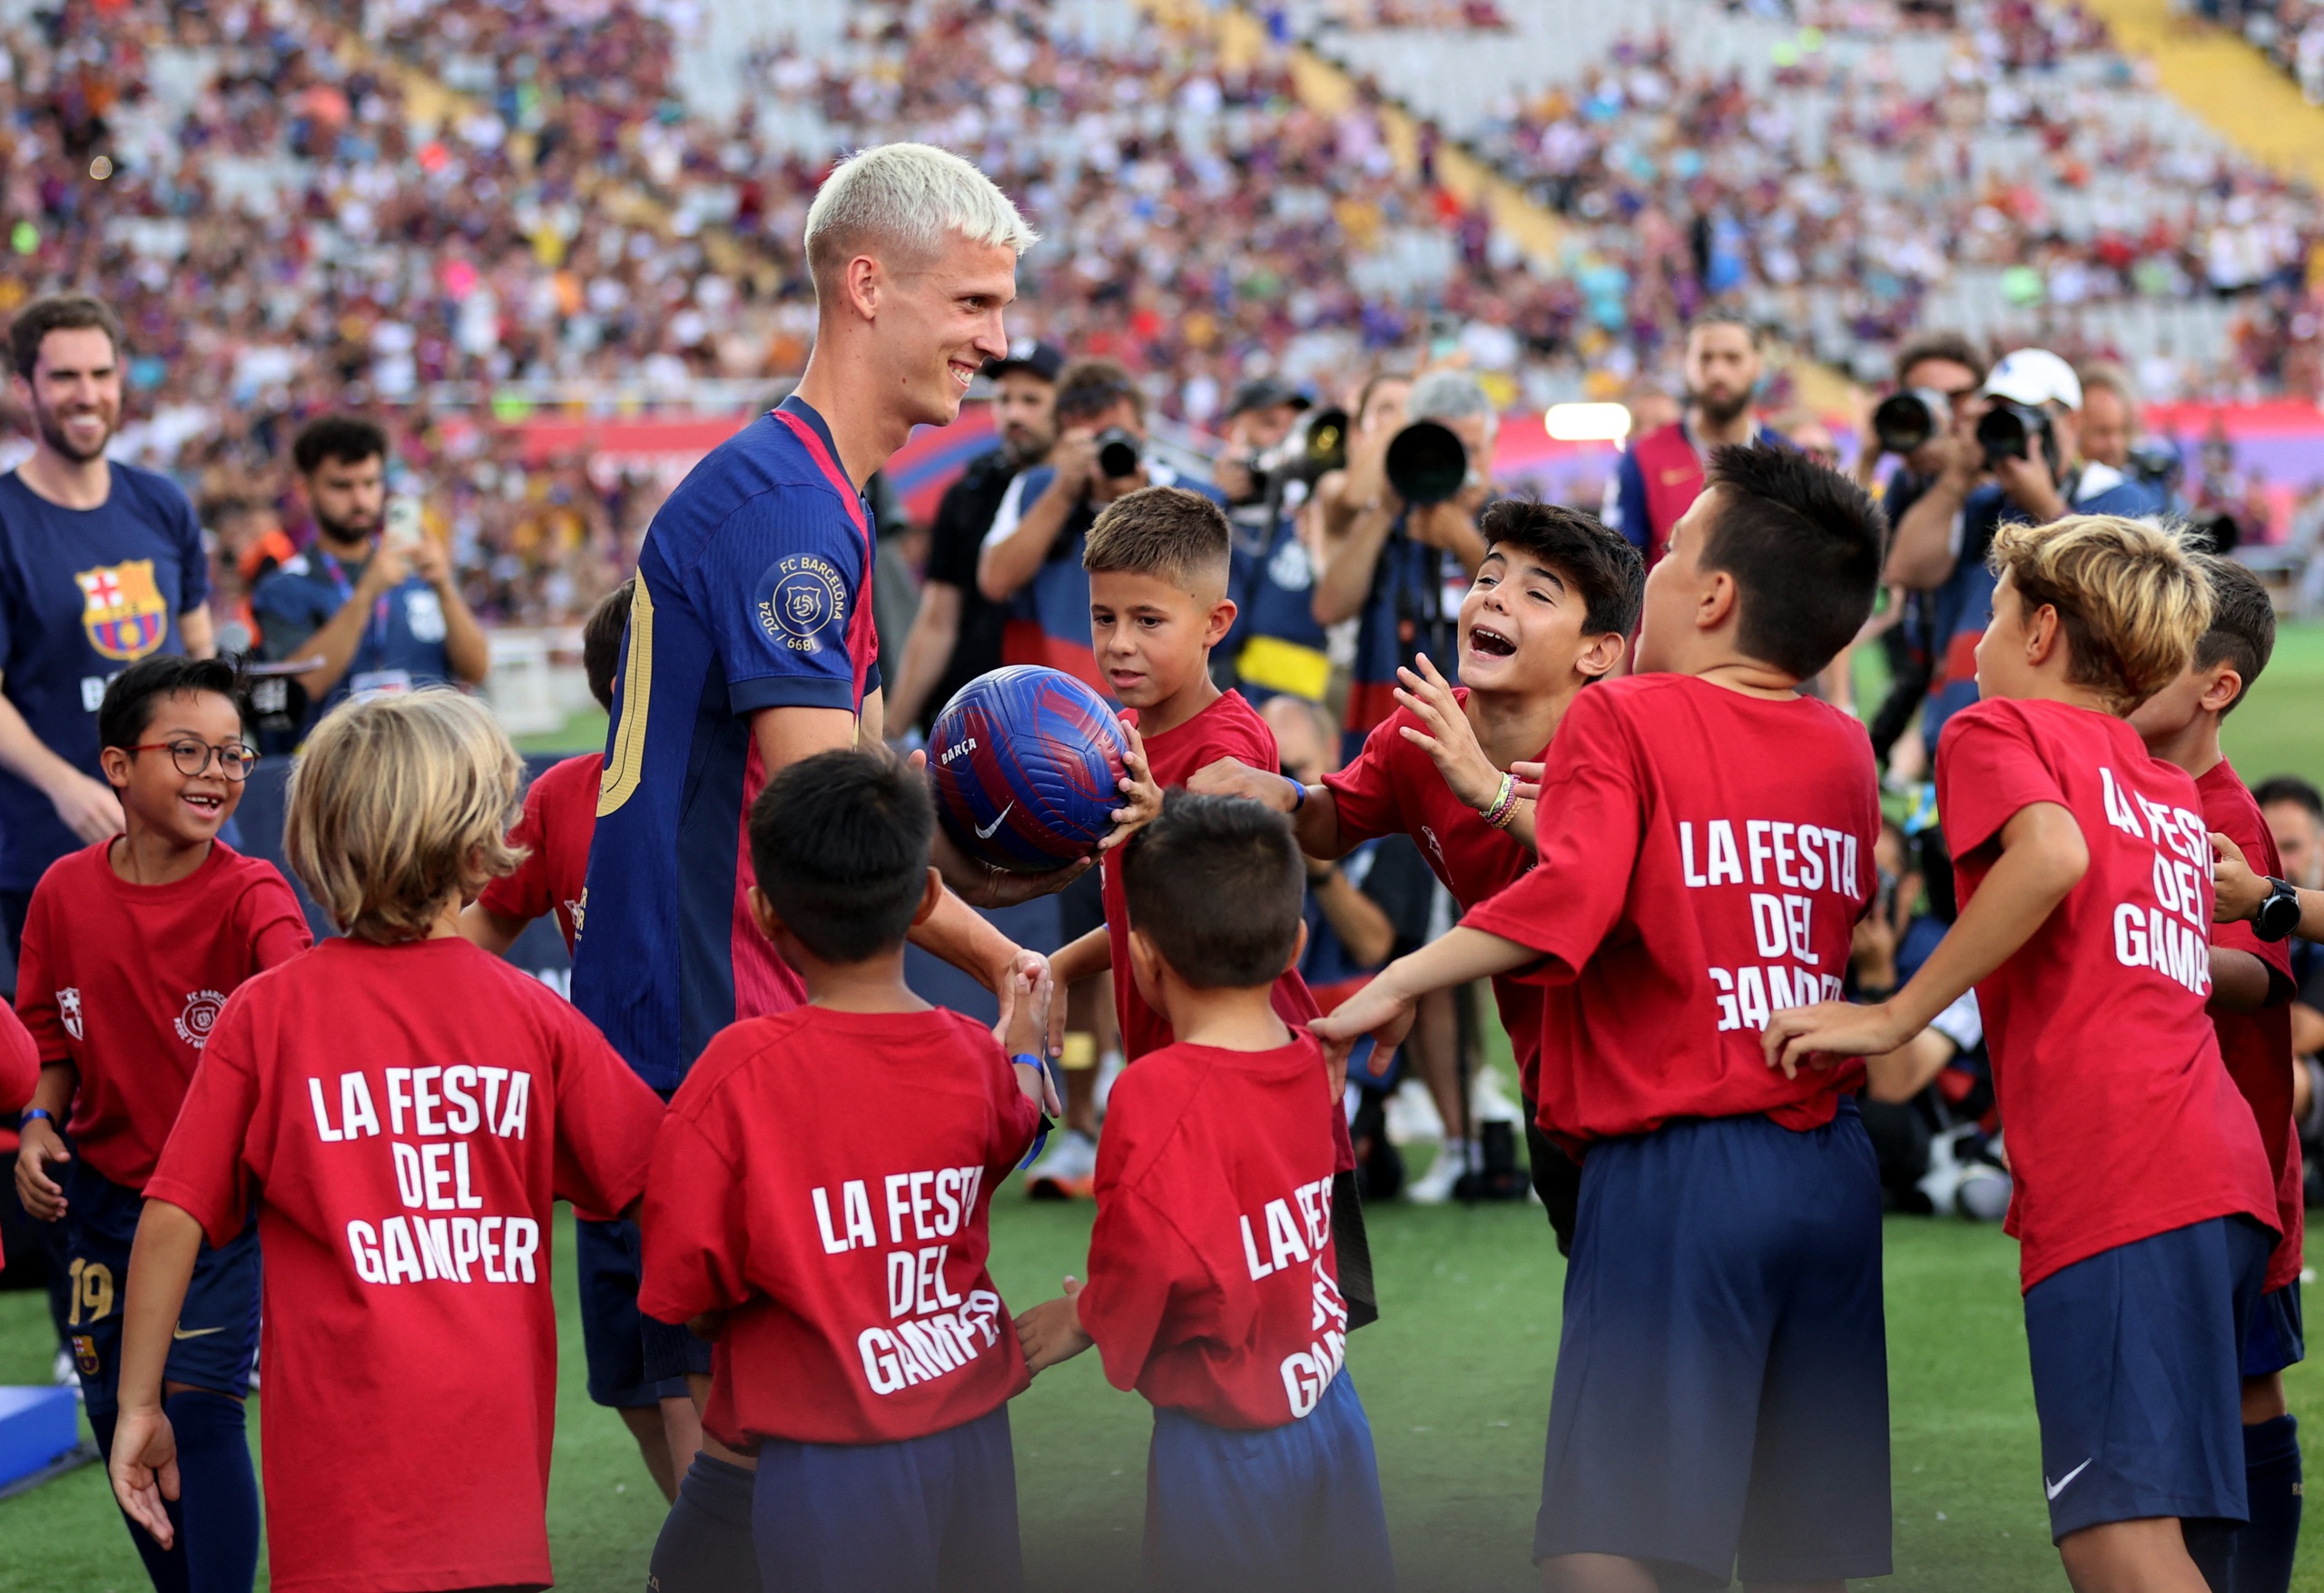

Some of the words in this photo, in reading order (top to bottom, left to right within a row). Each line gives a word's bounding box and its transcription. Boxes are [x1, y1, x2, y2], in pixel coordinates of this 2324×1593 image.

[759, 601, 780, 635] 2024
[779, 558, 797, 574] FC
[801, 556, 844, 620] BARCELONA
[787, 637, 816, 651] 1899
[940, 737, 977, 765] BARÇA
[2099, 767, 2144, 839] LA
[1679, 819, 1744, 888] LA
[1746, 819, 1860, 900] FESTA
[2152, 848, 2206, 937] DEL
[1749, 892, 1819, 965] DEL
[2113, 902, 2212, 997] GAMP
[308, 1071, 380, 1142] LA
[385, 1064, 531, 1141] FESTA
[391, 1141, 483, 1211] DEL
[347, 1215, 539, 1285] GAMPER
[812, 1179, 877, 1254] LA
[1239, 1197, 1310, 1282] LA
[68, 1257, 114, 1325] 19
[887, 1244, 962, 1319] DEL
